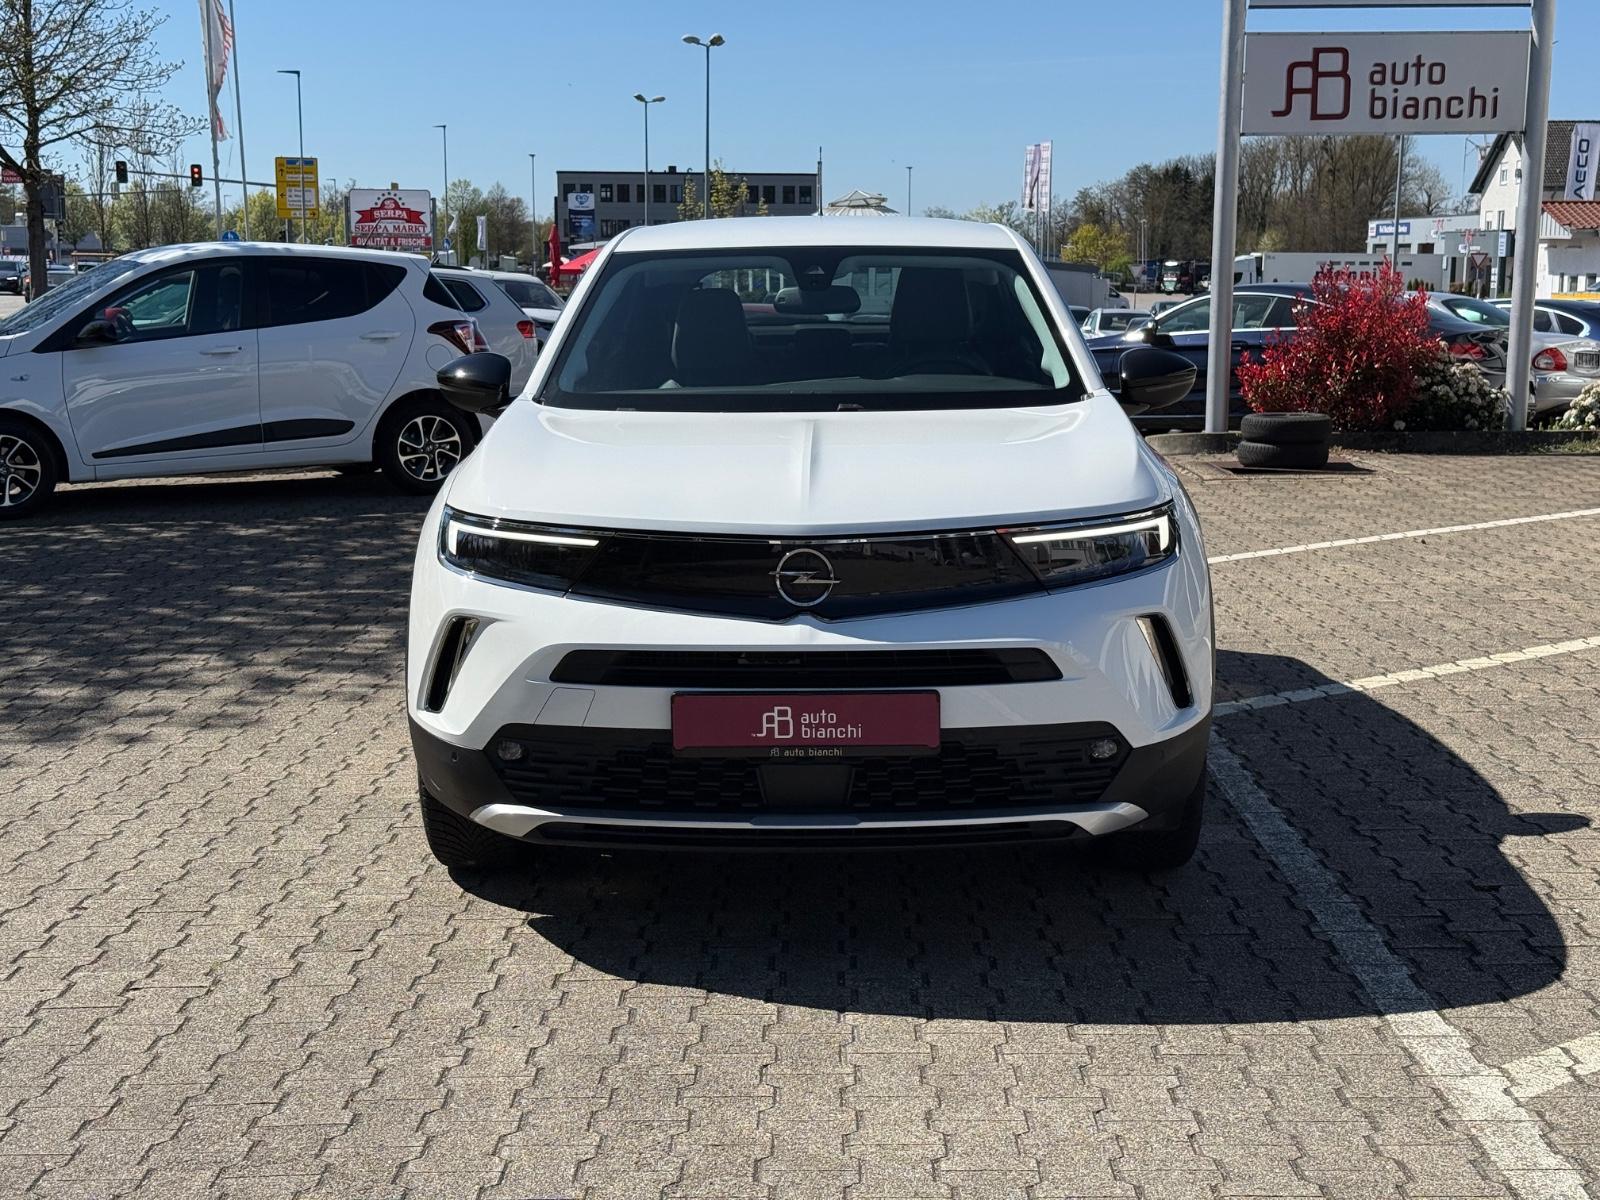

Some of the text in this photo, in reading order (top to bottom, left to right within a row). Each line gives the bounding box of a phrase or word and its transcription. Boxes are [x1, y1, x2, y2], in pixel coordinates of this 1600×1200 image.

[1369, 54, 1446, 86] auto
[1369, 86, 1499, 120] bianchi
[373, 210, 408, 219] SERPA
[355, 224, 428, 233] SERPA MARKT
[390, 238, 396, 246] &
[397, 237, 426, 246] FRISCHE
[800, 709, 837, 724] auto
[801, 723, 863, 739] bianchi
[783, 748, 805, 757] auto
[808, 748, 843, 757] bianchi
